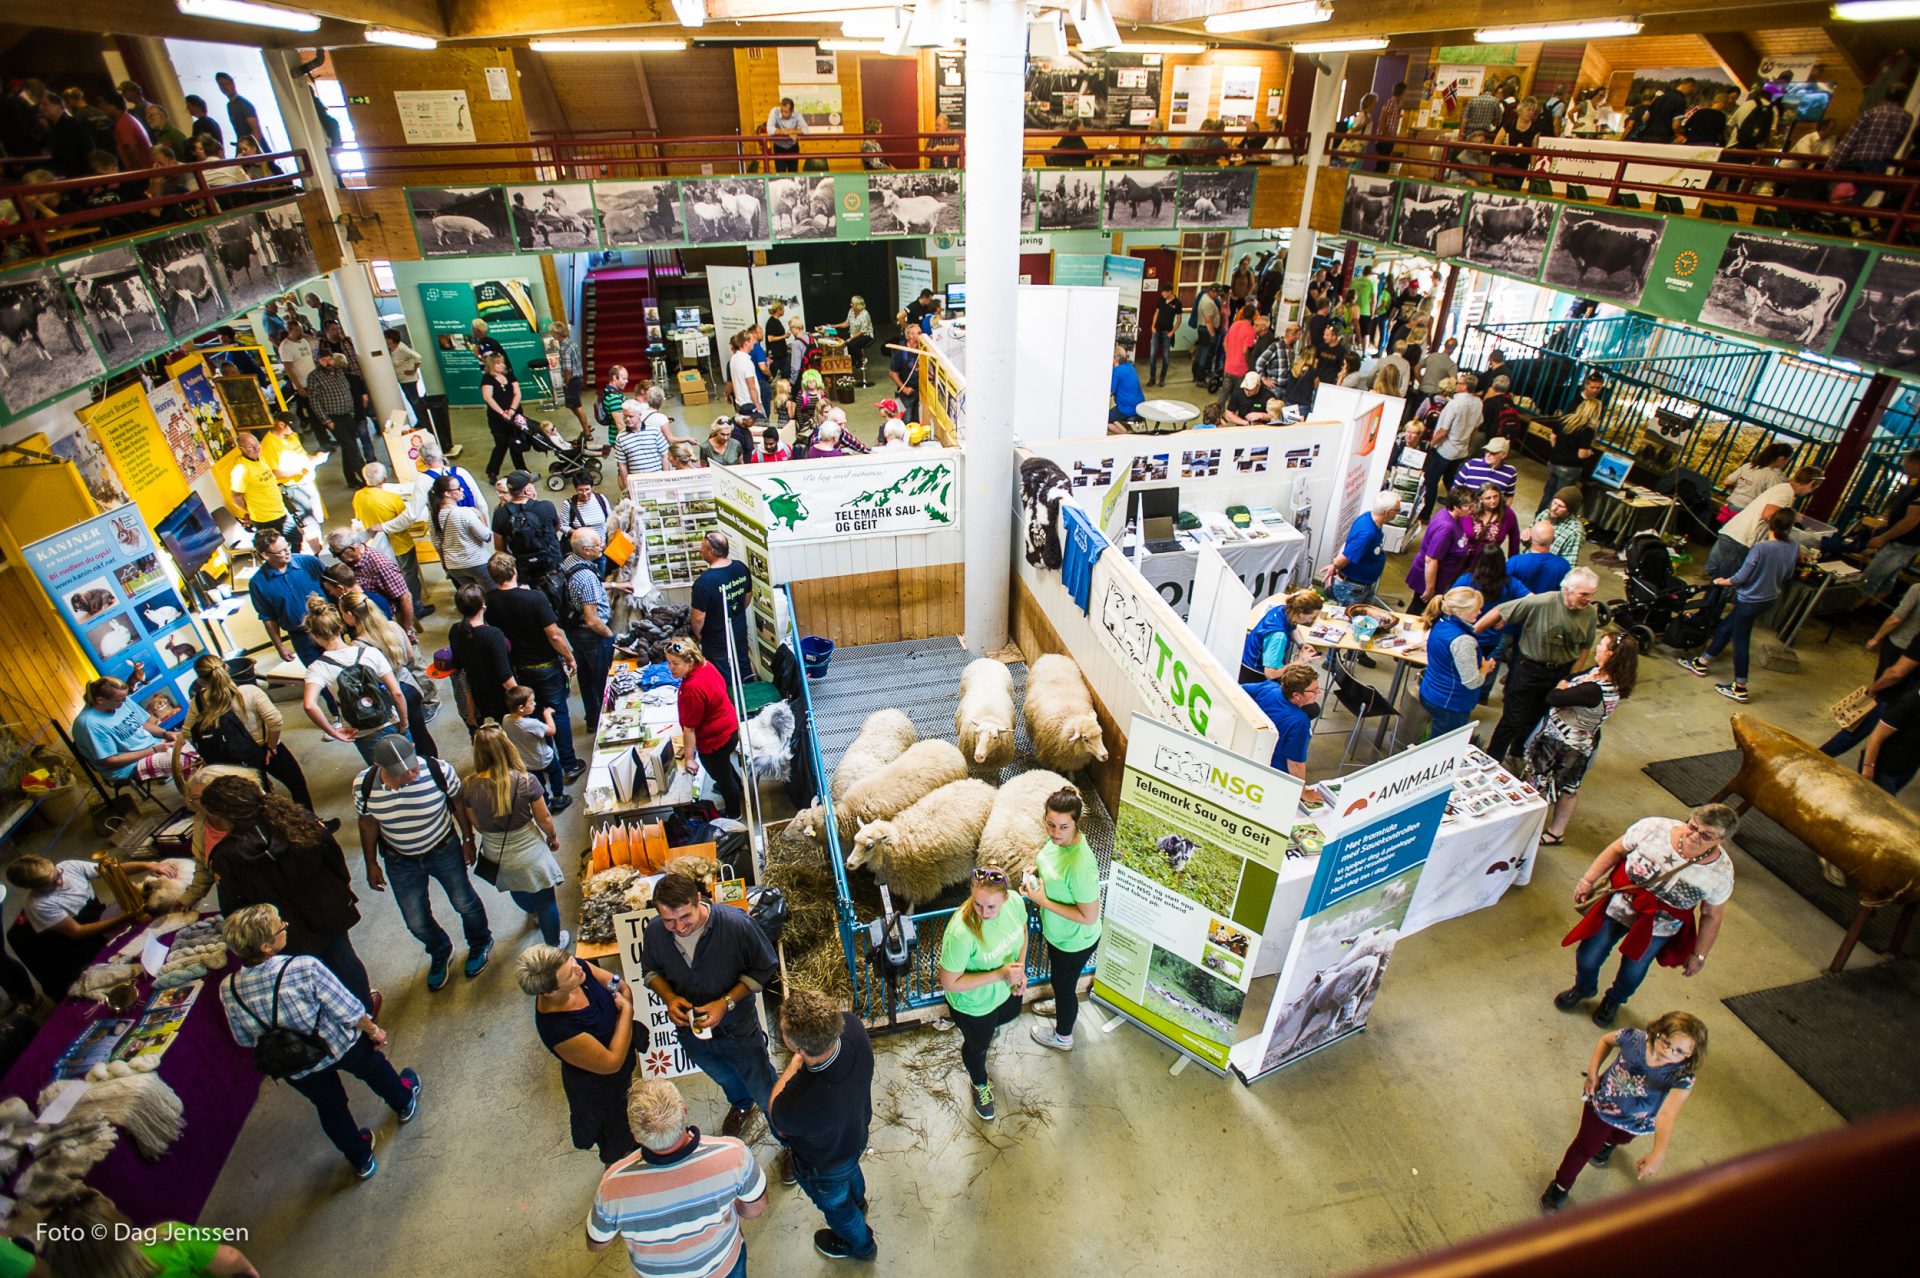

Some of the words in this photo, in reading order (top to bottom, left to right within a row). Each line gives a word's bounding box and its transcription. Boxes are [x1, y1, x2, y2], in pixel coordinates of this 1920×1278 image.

[821, 359, 851, 371] ØVE
[736, 488, 755, 508] NSG
[835, 507, 892, 521] TELEMARK
[895, 505, 921, 516] SAU-
[835, 522, 850, 533] OG
[854, 520, 878, 531] GEIT
[35, 527, 101, 562] KANINER
[48, 570, 58, 581] Bli
[58, 560, 84, 577] medlem
[86, 556, 94, 565] du
[96, 548, 112, 560] også!
[54, 557, 117, 590] www.kanin-nkf.net
[1154, 632, 1212, 737] TSG
[1211, 767, 1265, 803] NSG
[1376, 757, 1455, 803] ANIMALIA
[1135, 776, 1191, 811] Telemark
[1194, 803, 1218, 823] Sau
[1220, 820, 1238, 835] og
[1242, 825, 1272, 847] Geit
[1341, 849, 1360, 862] med
[1360, 822, 1421, 854] Sauekontrollen
[1362, 823, 1398, 844] framtida
[1116, 882, 1130, 892] med
[1130, 888, 1148, 902] fokus
[1116, 876, 1135, 888] under
[1136, 885, 1151, 896] NSG
[1152, 894, 1163, 903] sitt
[1164, 900, 1188, 914] arbeid
[1117, 868, 1126, 876] Bli
[1127, 872, 1154, 890] medlem
[1154, 888, 1162, 896] og
[1164, 893, 1180, 902] støtt
[1180, 901, 1194, 912] opp
